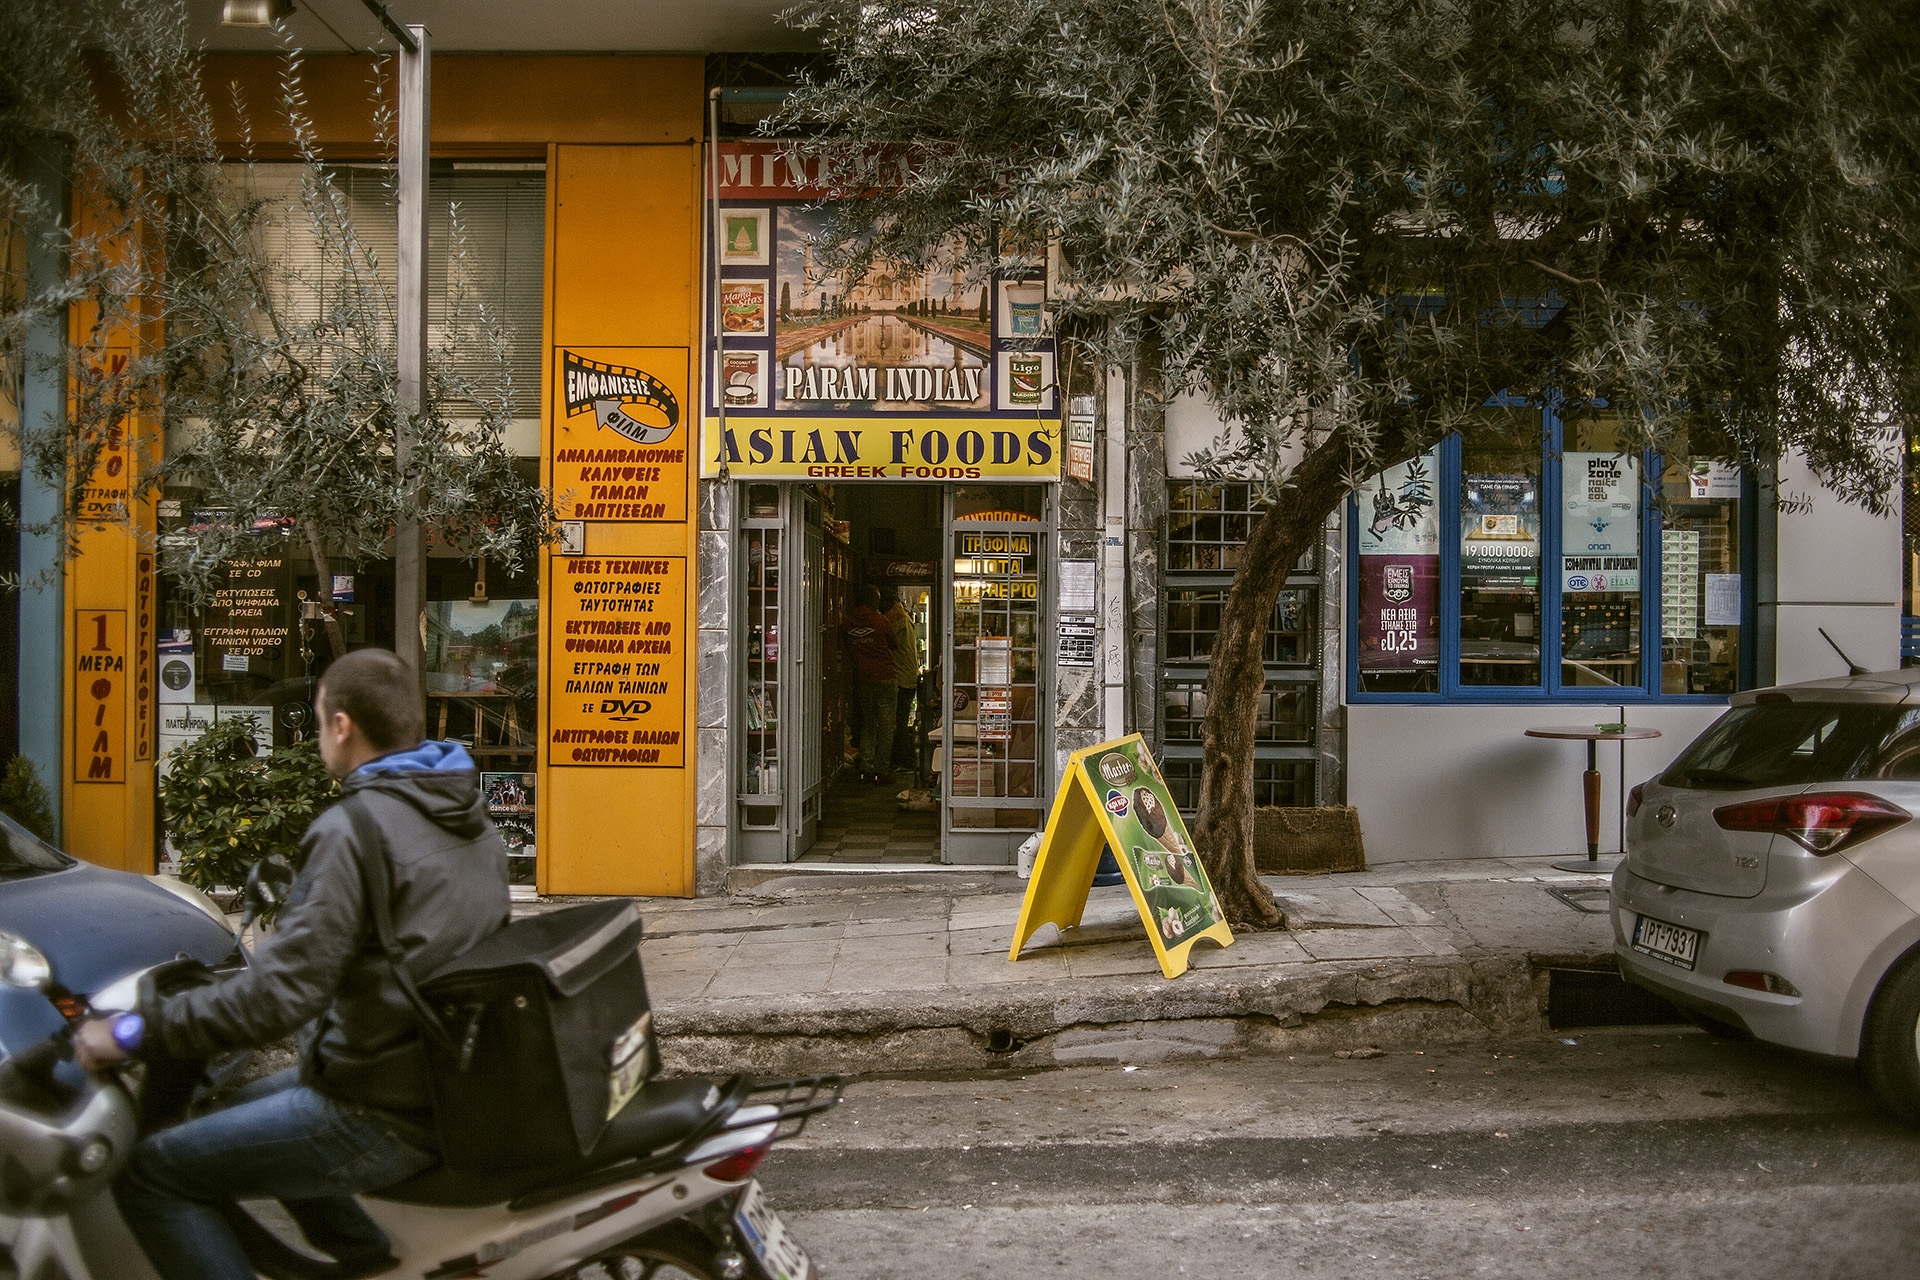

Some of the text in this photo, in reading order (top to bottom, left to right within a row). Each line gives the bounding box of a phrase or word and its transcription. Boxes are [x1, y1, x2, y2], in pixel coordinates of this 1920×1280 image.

[1012, 363, 1039, 375] Ligo
[568, 370, 651, 404] ΕΜΦΑΝΙΣΕΙΣ
[785, 366, 981, 402] PARAM INDIAN
[606, 411, 648, 441] ΦΙΛΜ
[714, 426, 1053, 467] ASIAN FOODS
[557, 449, 685, 464] ΑΝΑΛΑΜΒΑΝΟΥΜΕ
[1587, 457, 1617, 470] play
[580, 466, 661, 483] ΚΑΛΥΨΕΙΣ
[807, 465, 981, 479] GREEK FOODS
[1588, 470, 1621, 478] zone
[590, 485, 649, 501] ΓΑΜΩΝ
[574, 503, 666, 519] ΒΑΠΤΙΣΕΩΝ
[966, 537, 1029, 552] ΤΡΟΦΙΜΑ
[568, 560, 669, 575] ΝΕΕΣ ΤΕΧΝΙΚΕΣ
[215, 588, 275, 597] ΕΚΤΥΠΩΣΕΙΣ
[574, 581, 661, 595] ΦΩΤΟΓΡΑΦΙΕΣ
[211, 598, 280, 607] ΑΠΟ ΨΗΦΙΑΚΑ
[580, 599, 655, 612] ΤΑΥΤΟΤΗΤΑΣ
[228, 608, 263, 616] ΑΡΧΕΙΑ
[91, 614, 111, 651] 1
[204, 628, 289, 636] ΕΓΓΡΑΦΗ ΠΑΛΙΩΝ
[566, 620, 671, 635] ΕΚΤΥΠΩΣΕΙΣ ΑΠΟ
[228, 648, 264, 656] ΣΕ DVD
[565, 639, 671, 655] ΨΗΦΙΑΚΑ ΑΡΧΕΙΑ
[78, 655, 124, 673] ΜΕΡΑ
[573, 662, 660, 676] ΕΓΓΡΑΦΗ ΤΩΝ
[565, 680, 668, 695] ΠΑΛΙΩΝ ΤΑΙΝΙΩΝ
[582, 699, 652, 716] ΣΕ DVD
[88, 678, 112, 780] ΦΙΛΜ
[553, 729, 680, 744] ΑΝΤΙΓΡΑΦΕΣ ΠΑΛΙΩΝ
[572, 748, 660, 762] ΦΩΤΟΓΡΑΦΙΩΝ
[1101, 761, 1131, 781] Master
